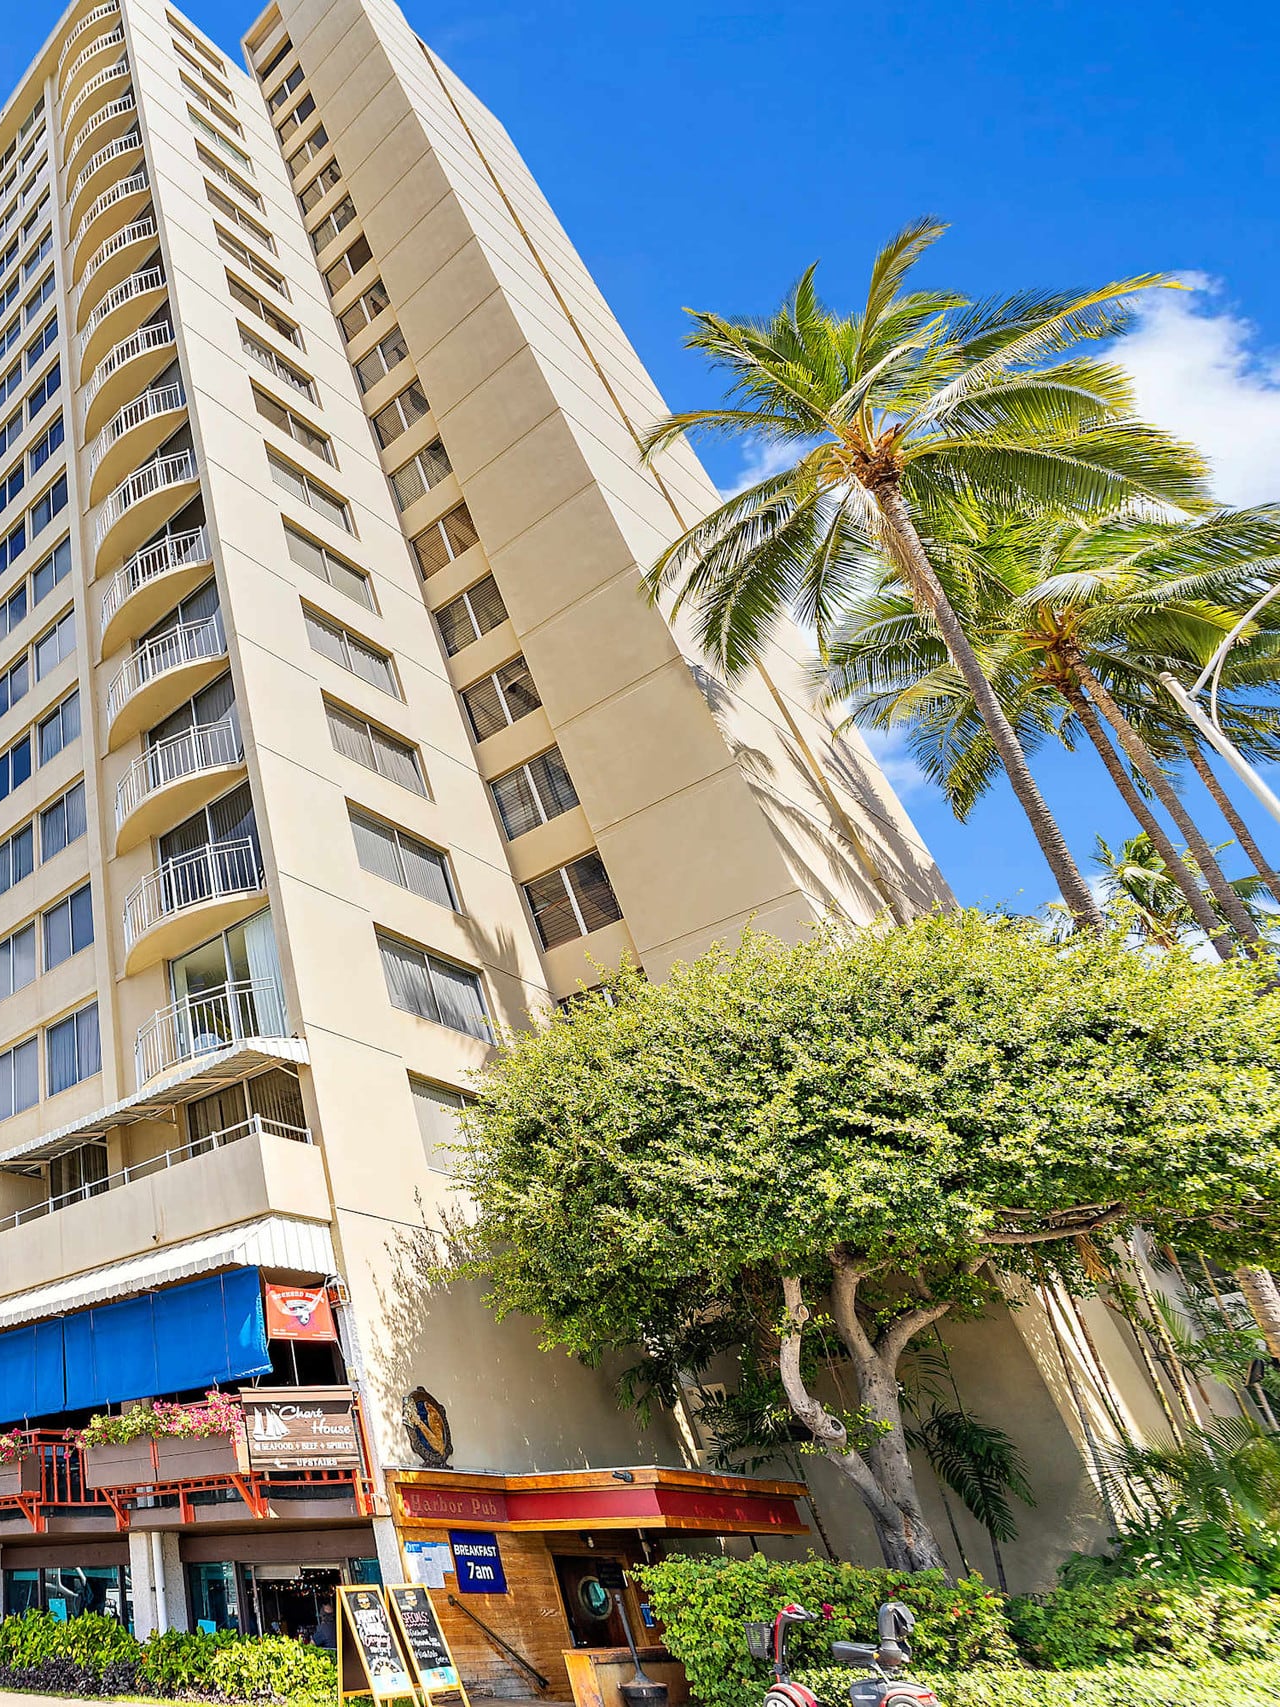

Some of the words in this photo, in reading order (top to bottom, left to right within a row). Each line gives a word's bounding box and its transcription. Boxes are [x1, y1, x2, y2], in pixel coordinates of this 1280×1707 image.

[279, 1405, 323, 1421] Chart
[310, 1417, 351, 1434] House
[262, 1442, 293, 1450] SEAFOOD
[301, 1442, 319, 1450] BEEF
[326, 1441, 354, 1449] SPIRITS
[296, 1458, 338, 1467] UPSTAIRS
[410, 1494, 463, 1513] Harbor
[471, 1497, 497, 1516] Pub
[453, 1544, 497, 1557] BREAKFAST
[467, 1561, 494, 1580] 7am
